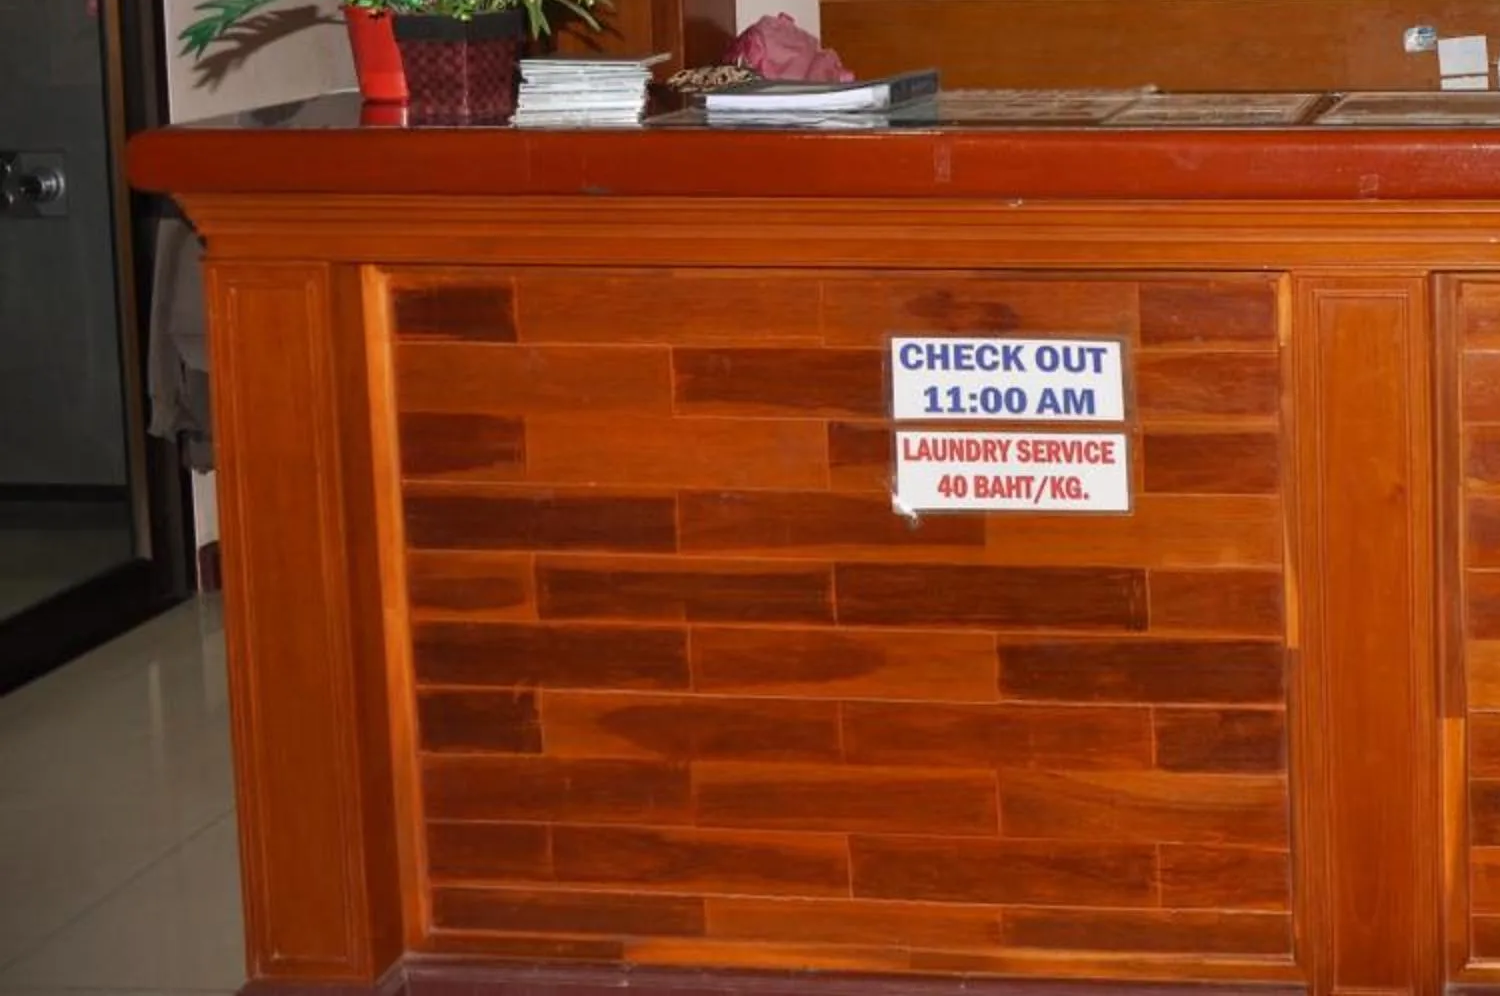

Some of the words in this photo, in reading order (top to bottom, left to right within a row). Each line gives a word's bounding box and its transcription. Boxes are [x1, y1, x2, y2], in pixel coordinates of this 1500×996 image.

[900, 343, 1025, 372] CHECK
[1035, 345, 1107, 374] OUT
[923, 386, 1027, 414] 11:00
[1036, 388, 1095, 415] AM
[903, 438, 1012, 463] LAUNDRY
[1016, 440, 1115, 464] SERVICE
[937, 475, 968, 498] 40
[974, 475, 1089, 503] BAHT/KG.
